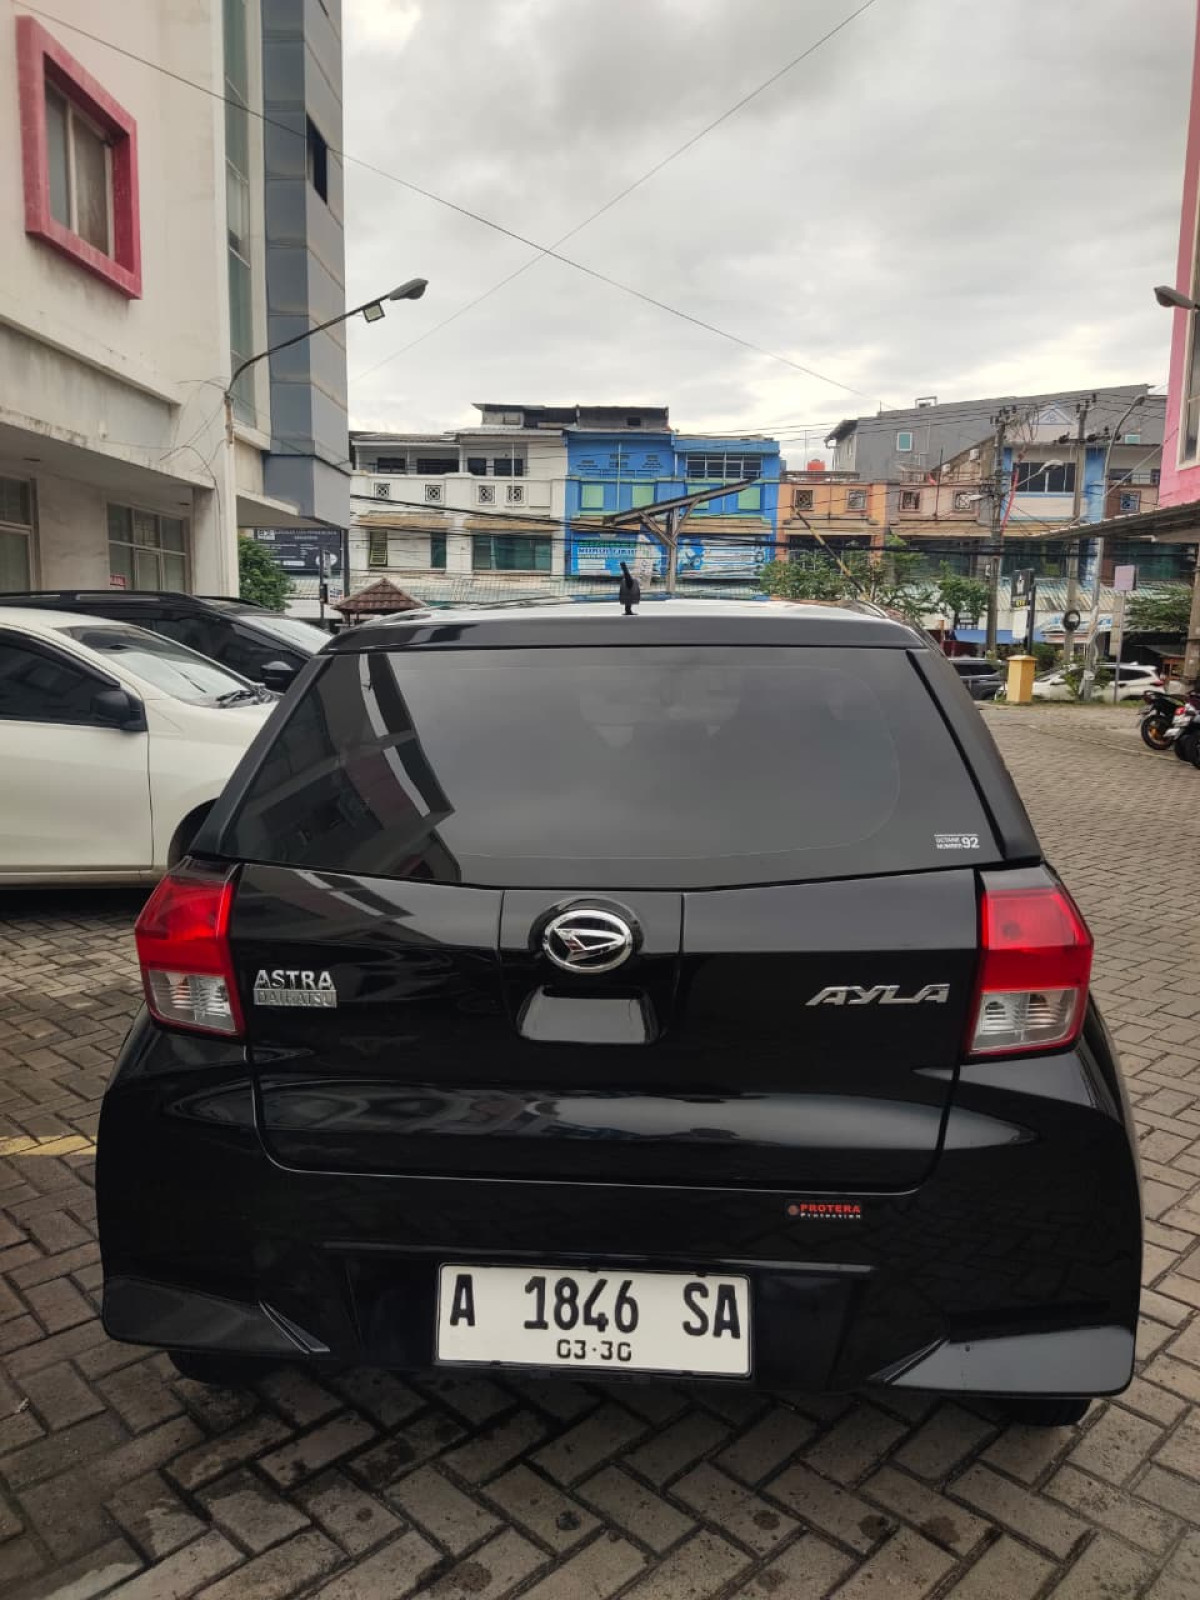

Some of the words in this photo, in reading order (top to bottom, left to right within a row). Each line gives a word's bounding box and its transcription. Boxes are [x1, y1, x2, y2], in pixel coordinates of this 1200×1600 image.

[961, 836, 980, 849] 92
[254, 969, 336, 990] ASTRA
[805, 983, 950, 1006] AYLA
[800, 1204, 861, 1213] PROTERA
[449, 1273, 476, 1327] A
[523, 1275, 639, 1334] 1846
[682, 1281, 741, 1340] SA
